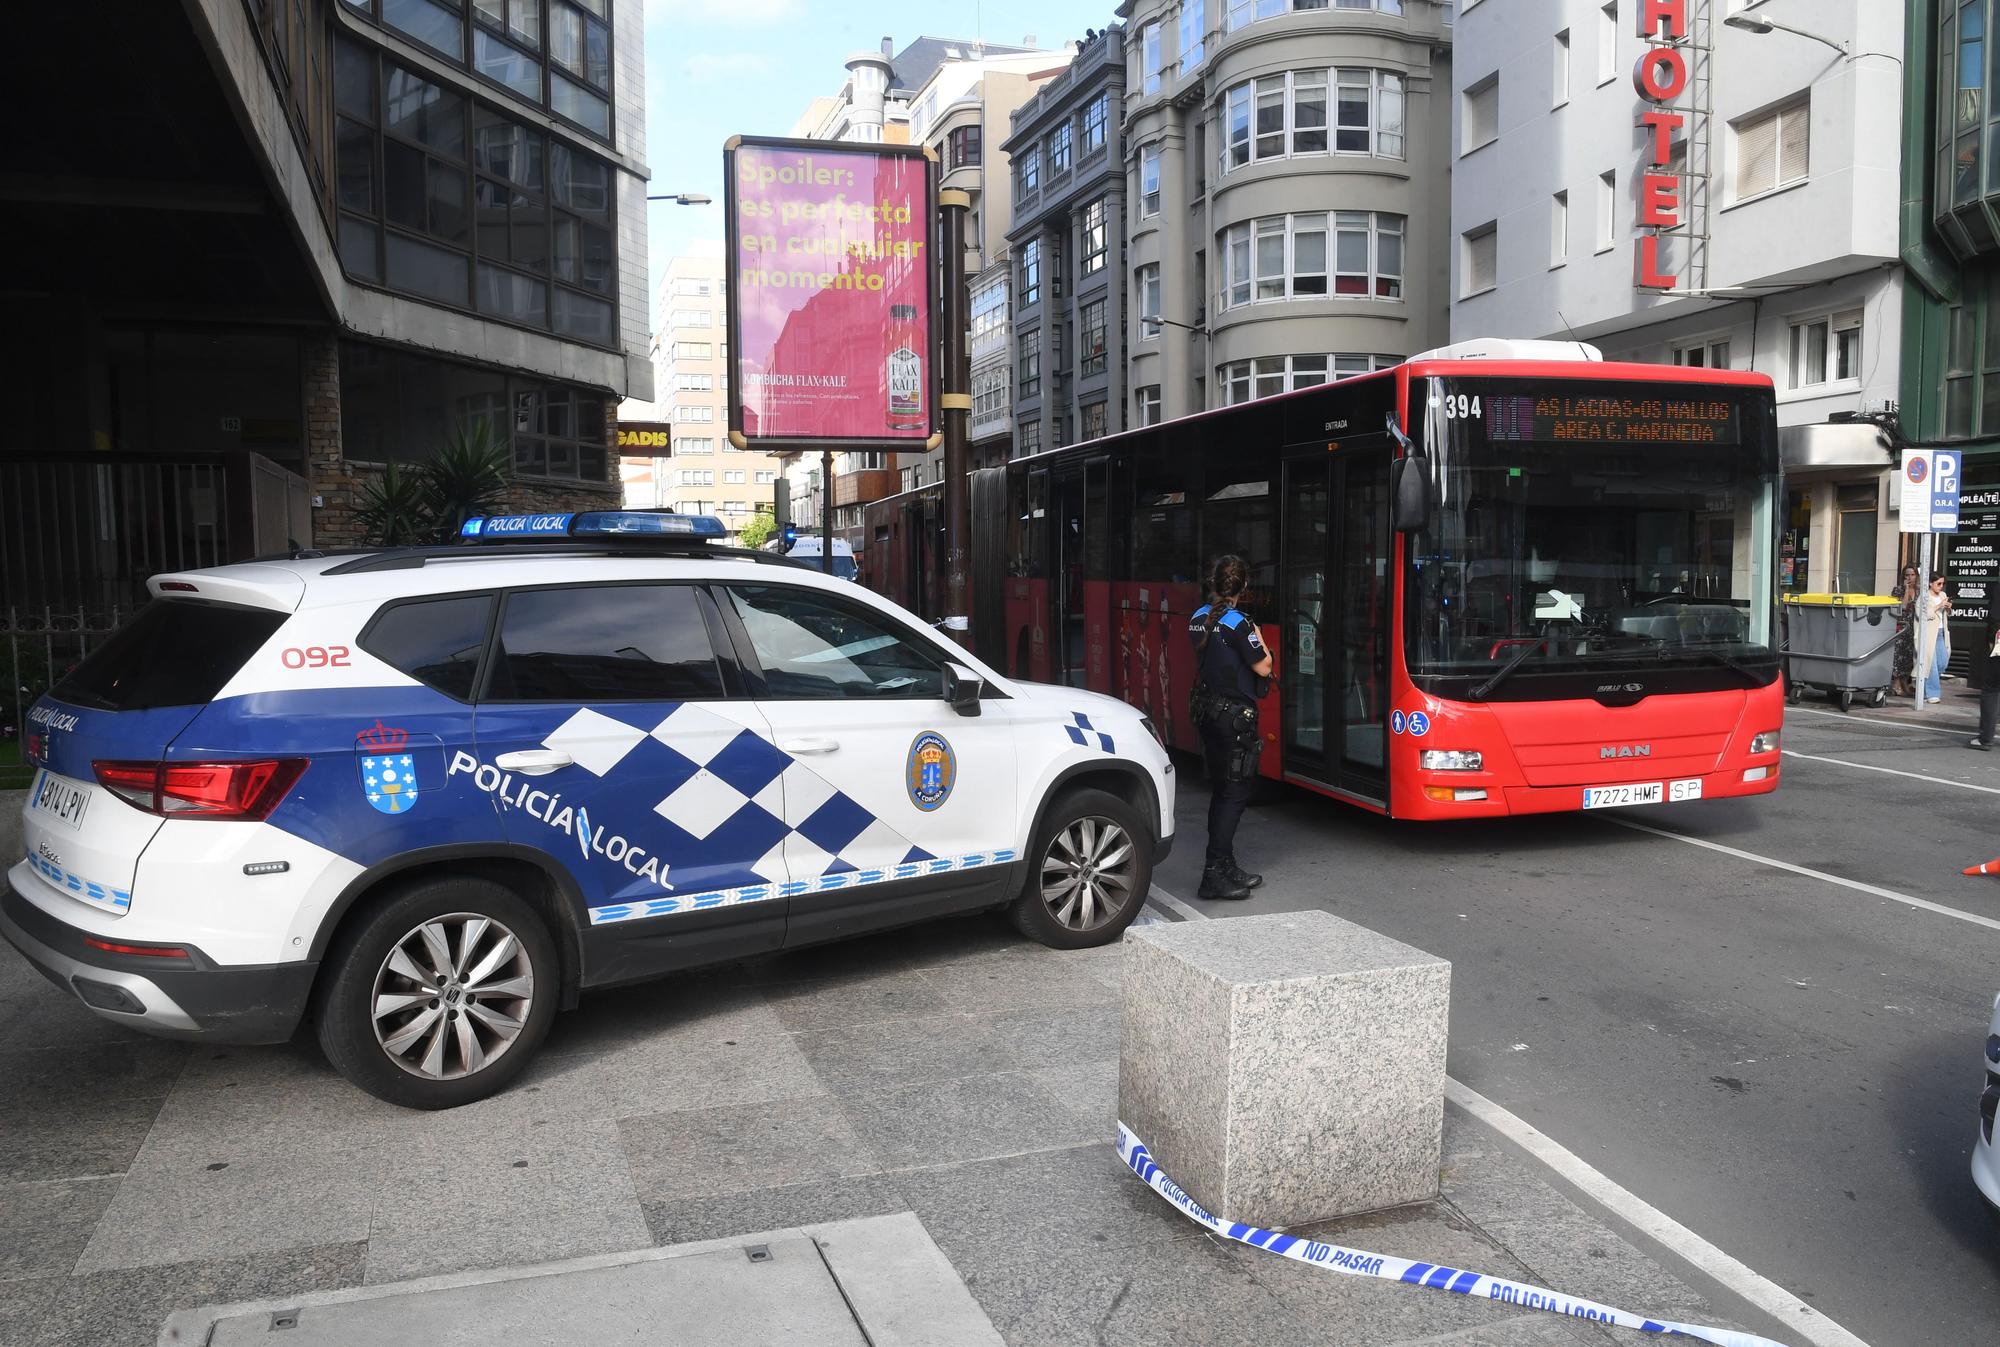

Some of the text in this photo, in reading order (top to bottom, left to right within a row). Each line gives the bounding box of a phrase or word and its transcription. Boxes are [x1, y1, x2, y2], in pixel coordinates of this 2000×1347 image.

[1634, 0, 1687, 289] HOTEL
[740, 156, 854, 191] Spoiler:
[740, 199, 773, 218] es
[741, 228, 924, 264] en cualquier
[741, 266, 884, 291] momento
[744, 373, 794, 386] KOMBUCHA
[892, 364, 917, 376] FLAX
[892, 379, 918, 390] KALE
[1446, 394, 1482, 419] 394
[1536, 398, 1729, 420] AS LAGOAS-OS MALLOS
[1325, 419, 1348, 431] ENTRADA
[1493, 397, 1521, 440] 11
[617, 431, 668, 447] GADIS
[1626, 422, 1714, 441] MARINEDA
[1934, 454, 1956, 493] P
[532, 516, 567, 530] LOCAL
[1955, 545, 1993, 553] ATENDEMOS
[1969, 568, 1988, 576] BAJO
[1972, 558, 1998, 567] ANDRÉS
[281, 645, 351, 669] 092
[50, 713, 80, 732] LOCAL
[1600, 744, 1651, 759] MAN
[39, 777, 86, 823] 4814 LPV
[1593, 785, 1660, 805] 7272 HMF
[448, 750, 675, 891] POLICÍA LOCAL
[1302, 1241, 1385, 1275] NO PASAR
